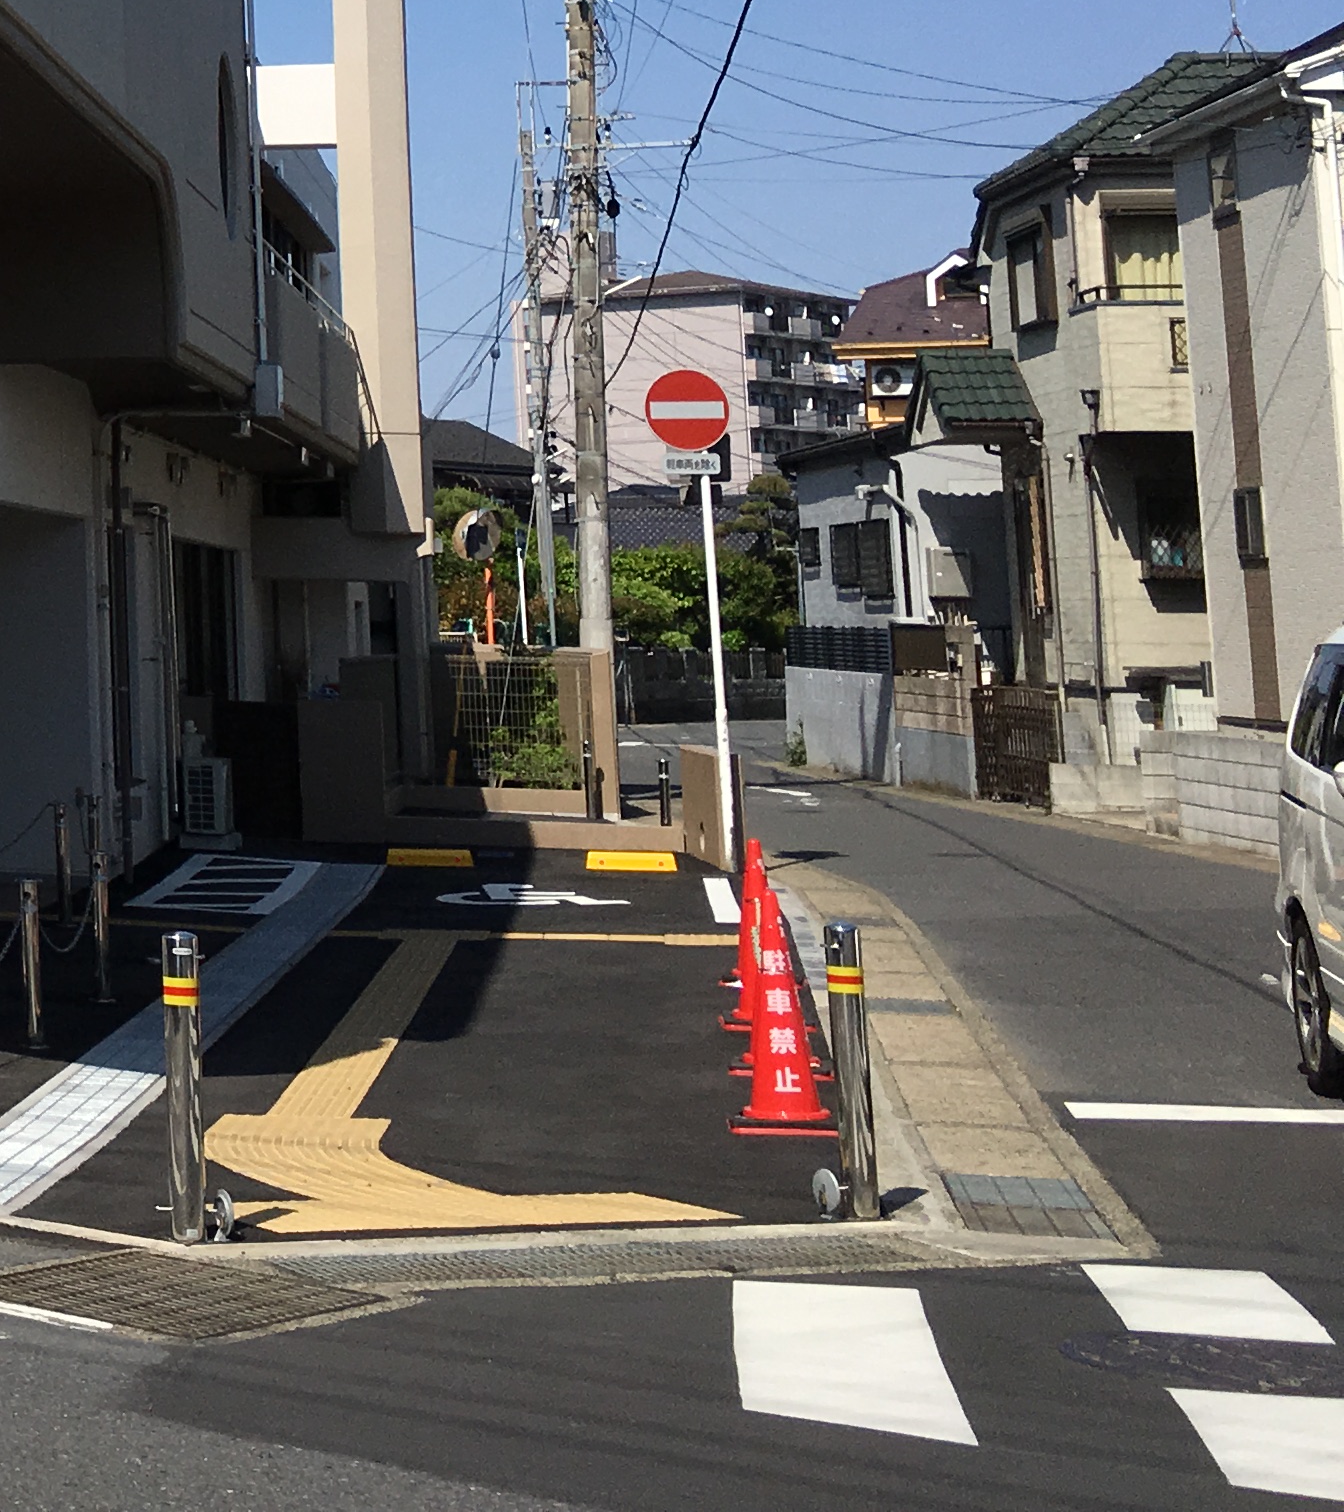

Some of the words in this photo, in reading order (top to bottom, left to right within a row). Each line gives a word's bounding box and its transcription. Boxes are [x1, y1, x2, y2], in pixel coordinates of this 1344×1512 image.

[666, 458, 717, 471] 軽車両を除く
[761, 948, 802, 1094] 駐車禁止
